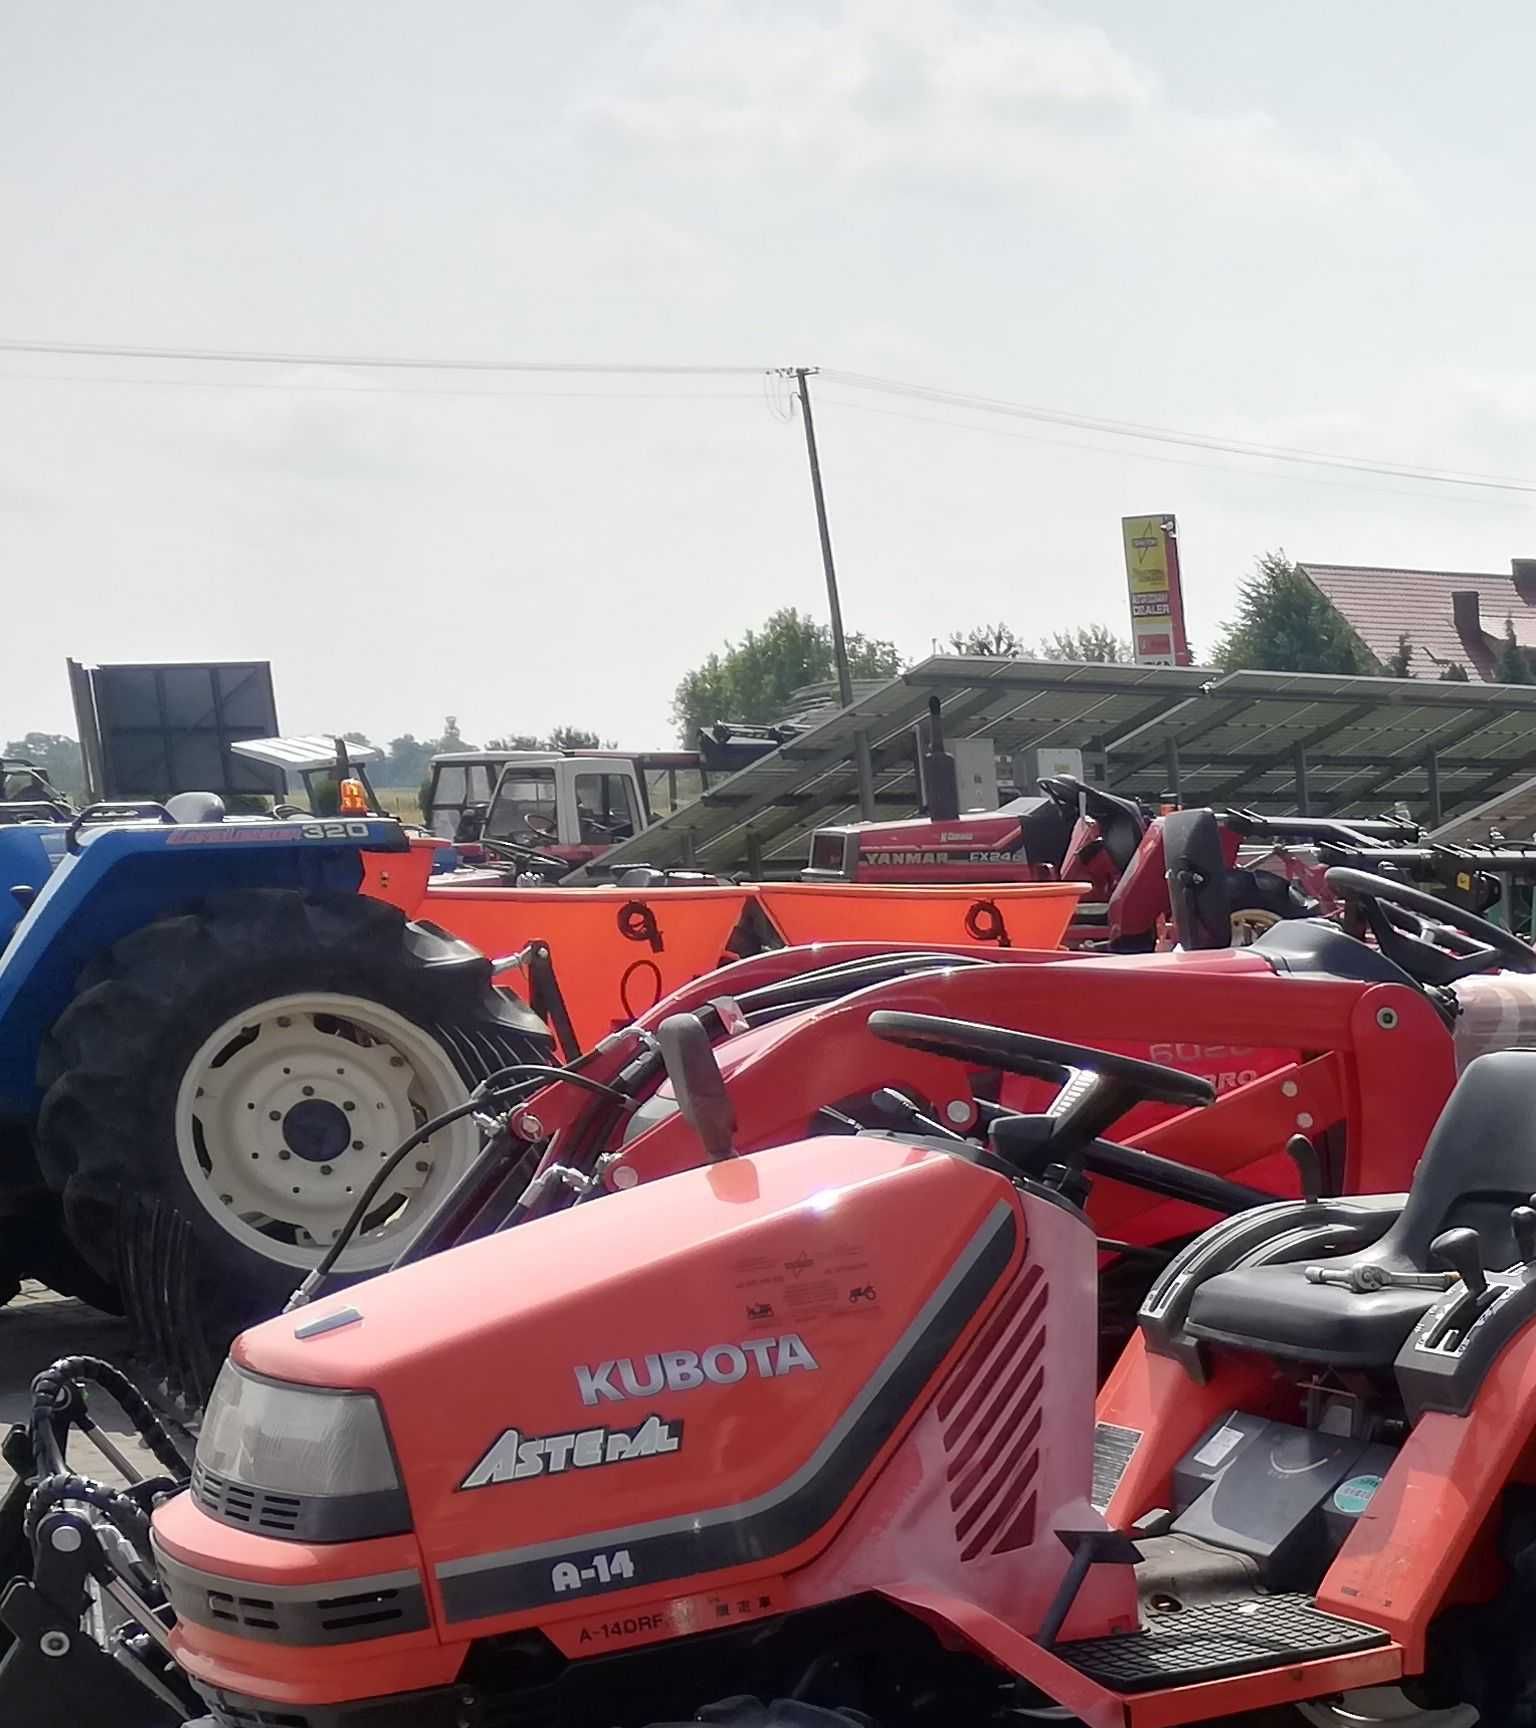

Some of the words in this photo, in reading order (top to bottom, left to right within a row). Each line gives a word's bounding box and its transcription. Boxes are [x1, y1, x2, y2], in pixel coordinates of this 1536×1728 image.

[302, 823, 369, 839] 320
[866, 853, 948, 865] YANMAR
[574, 1333, 818, 1405] KUBOTA
[552, 1550, 634, 1592] A-14
